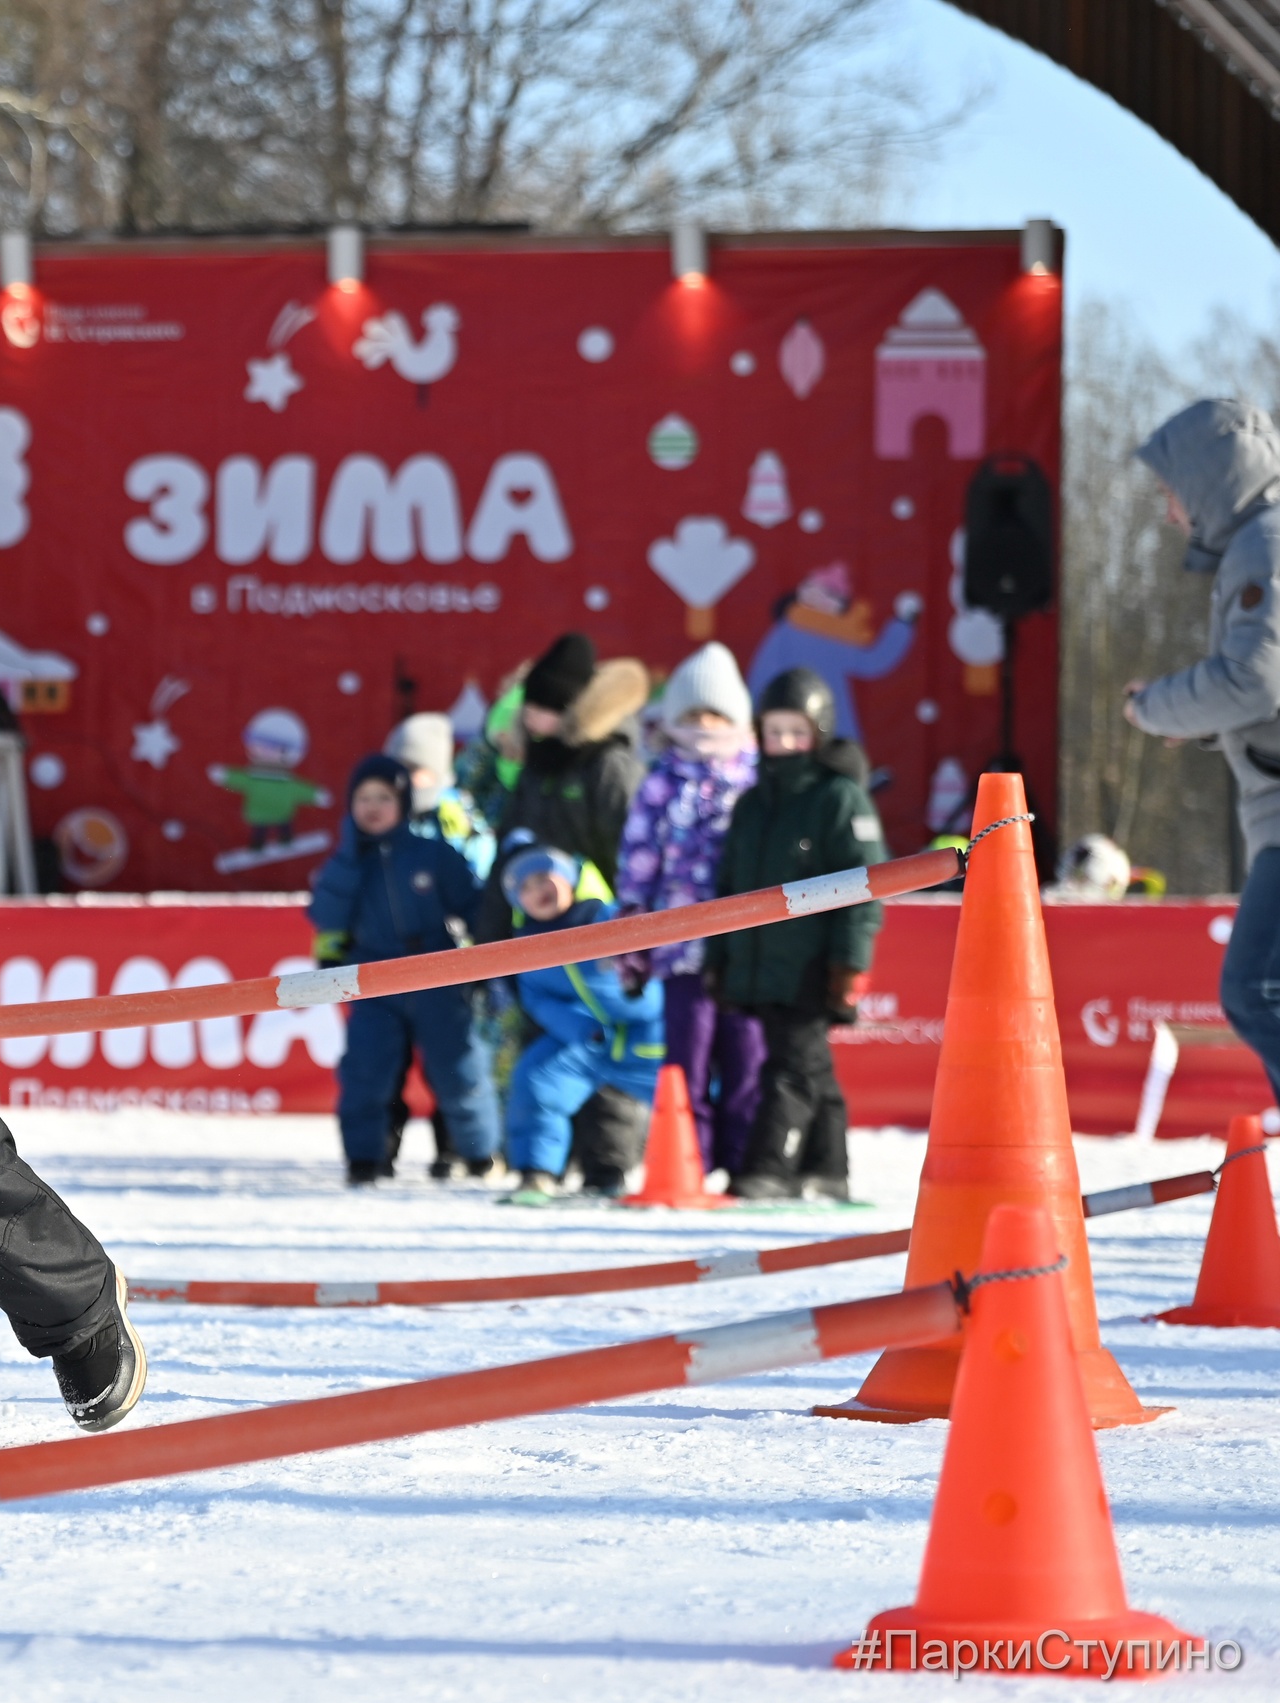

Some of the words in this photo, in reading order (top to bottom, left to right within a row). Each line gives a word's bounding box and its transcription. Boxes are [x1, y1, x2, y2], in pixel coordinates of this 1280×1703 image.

[123, 452, 573, 566] ЗИМА
[191, 586, 217, 613] в
[227, 575, 501, 617] Подмосковье
